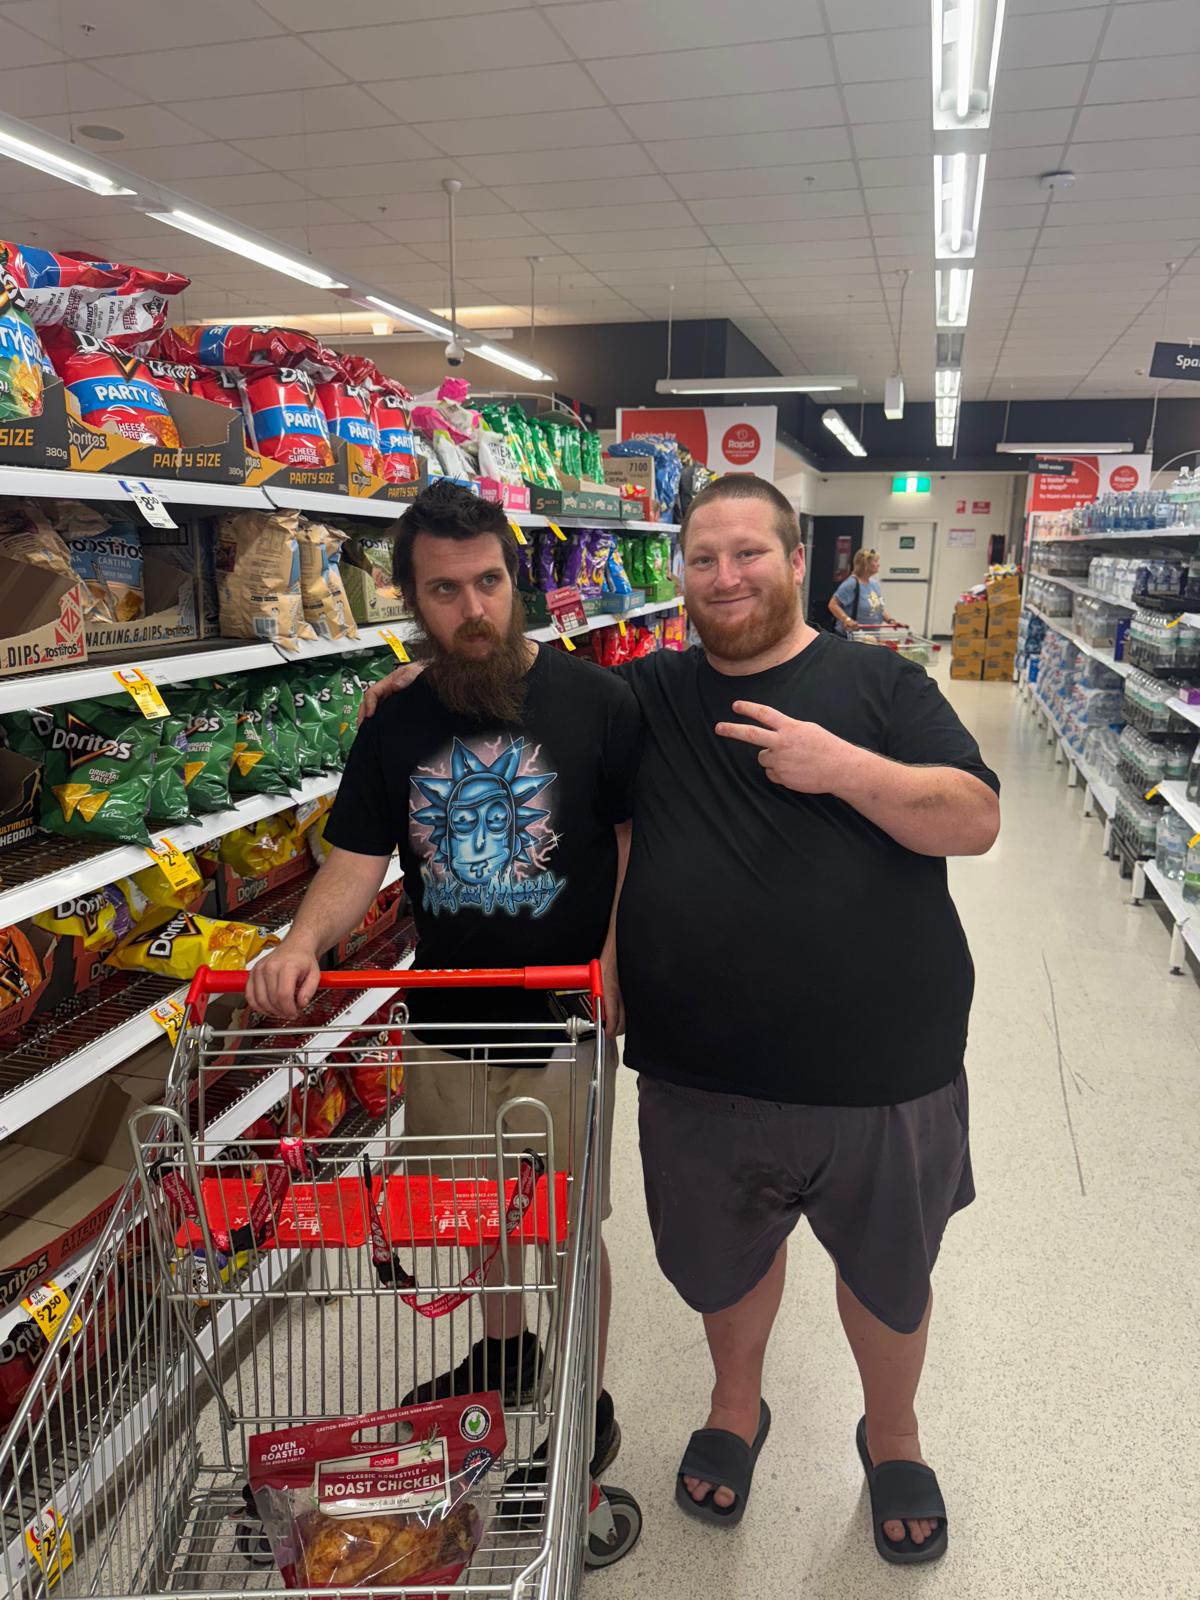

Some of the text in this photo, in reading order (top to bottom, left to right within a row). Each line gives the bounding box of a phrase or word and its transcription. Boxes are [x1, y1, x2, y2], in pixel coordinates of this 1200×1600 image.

[1176, 354, 1200, 370] Spa
[94, 385, 149, 403] PARTY
[292, 447, 317, 456] CHEESE
[728, 439, 755, 450] Rapid
[46, 447, 68, 460] 380g
[153, 453, 221, 468] PARTY SIZE
[629, 463, 648, 472] 7100
[290, 473, 335, 484] PARTY SIZE
[85, 629, 129, 646] NACKING
[143, 625, 162, 641] DIPS
[7, 644, 41, 666] DIPS
[53, 728, 133, 760] Doritos
[0, 825, 38, 847] HEDDAR
[0, 1252, 48, 1302] oritos
[261, 1447, 306, 1461] ROASTED
[270, 1441, 296, 1453] OVEN
[372, 1456, 396, 1467] coles
[346, 1467, 420, 1480] CLASSIC HOMESTYLE
[324, 1473, 440, 1497] ROAST CHICKEN
